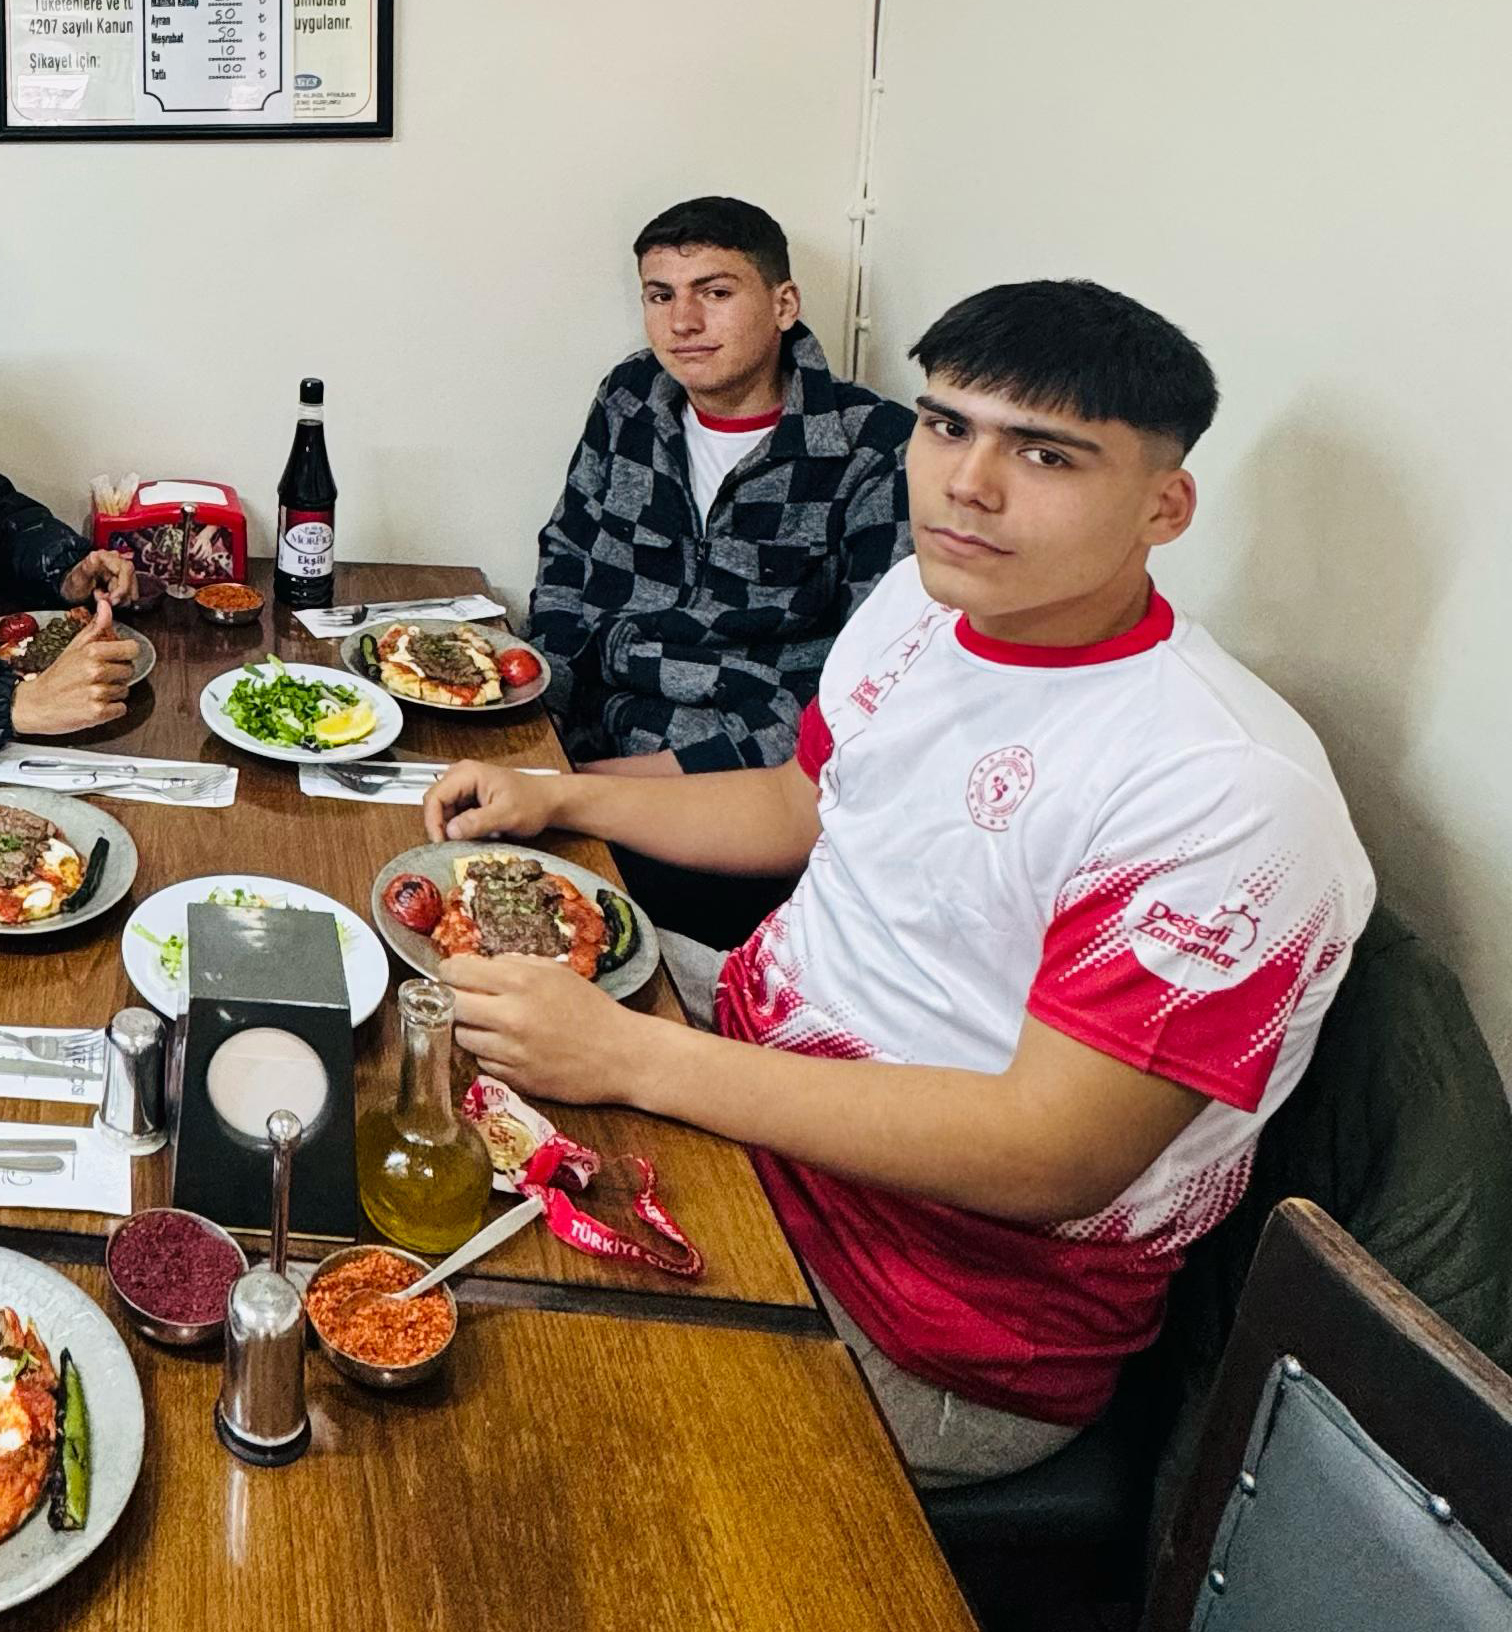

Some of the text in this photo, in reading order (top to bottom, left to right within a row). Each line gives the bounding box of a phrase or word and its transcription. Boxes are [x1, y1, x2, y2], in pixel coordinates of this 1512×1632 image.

[107, 0, 120, 11] ve
[29, 17, 134, 37] 4207 sayılı Kanun
[29, 52, 72, 73] Şikayet
[218, 63, 243, 73] 100
[302, 566, 322, 575] Sos
[1146, 900, 1231, 946] Değerli
[1133, 916, 1240, 969] Zamanlar
[571, 1219, 641, 1258] TÜRKİYE
